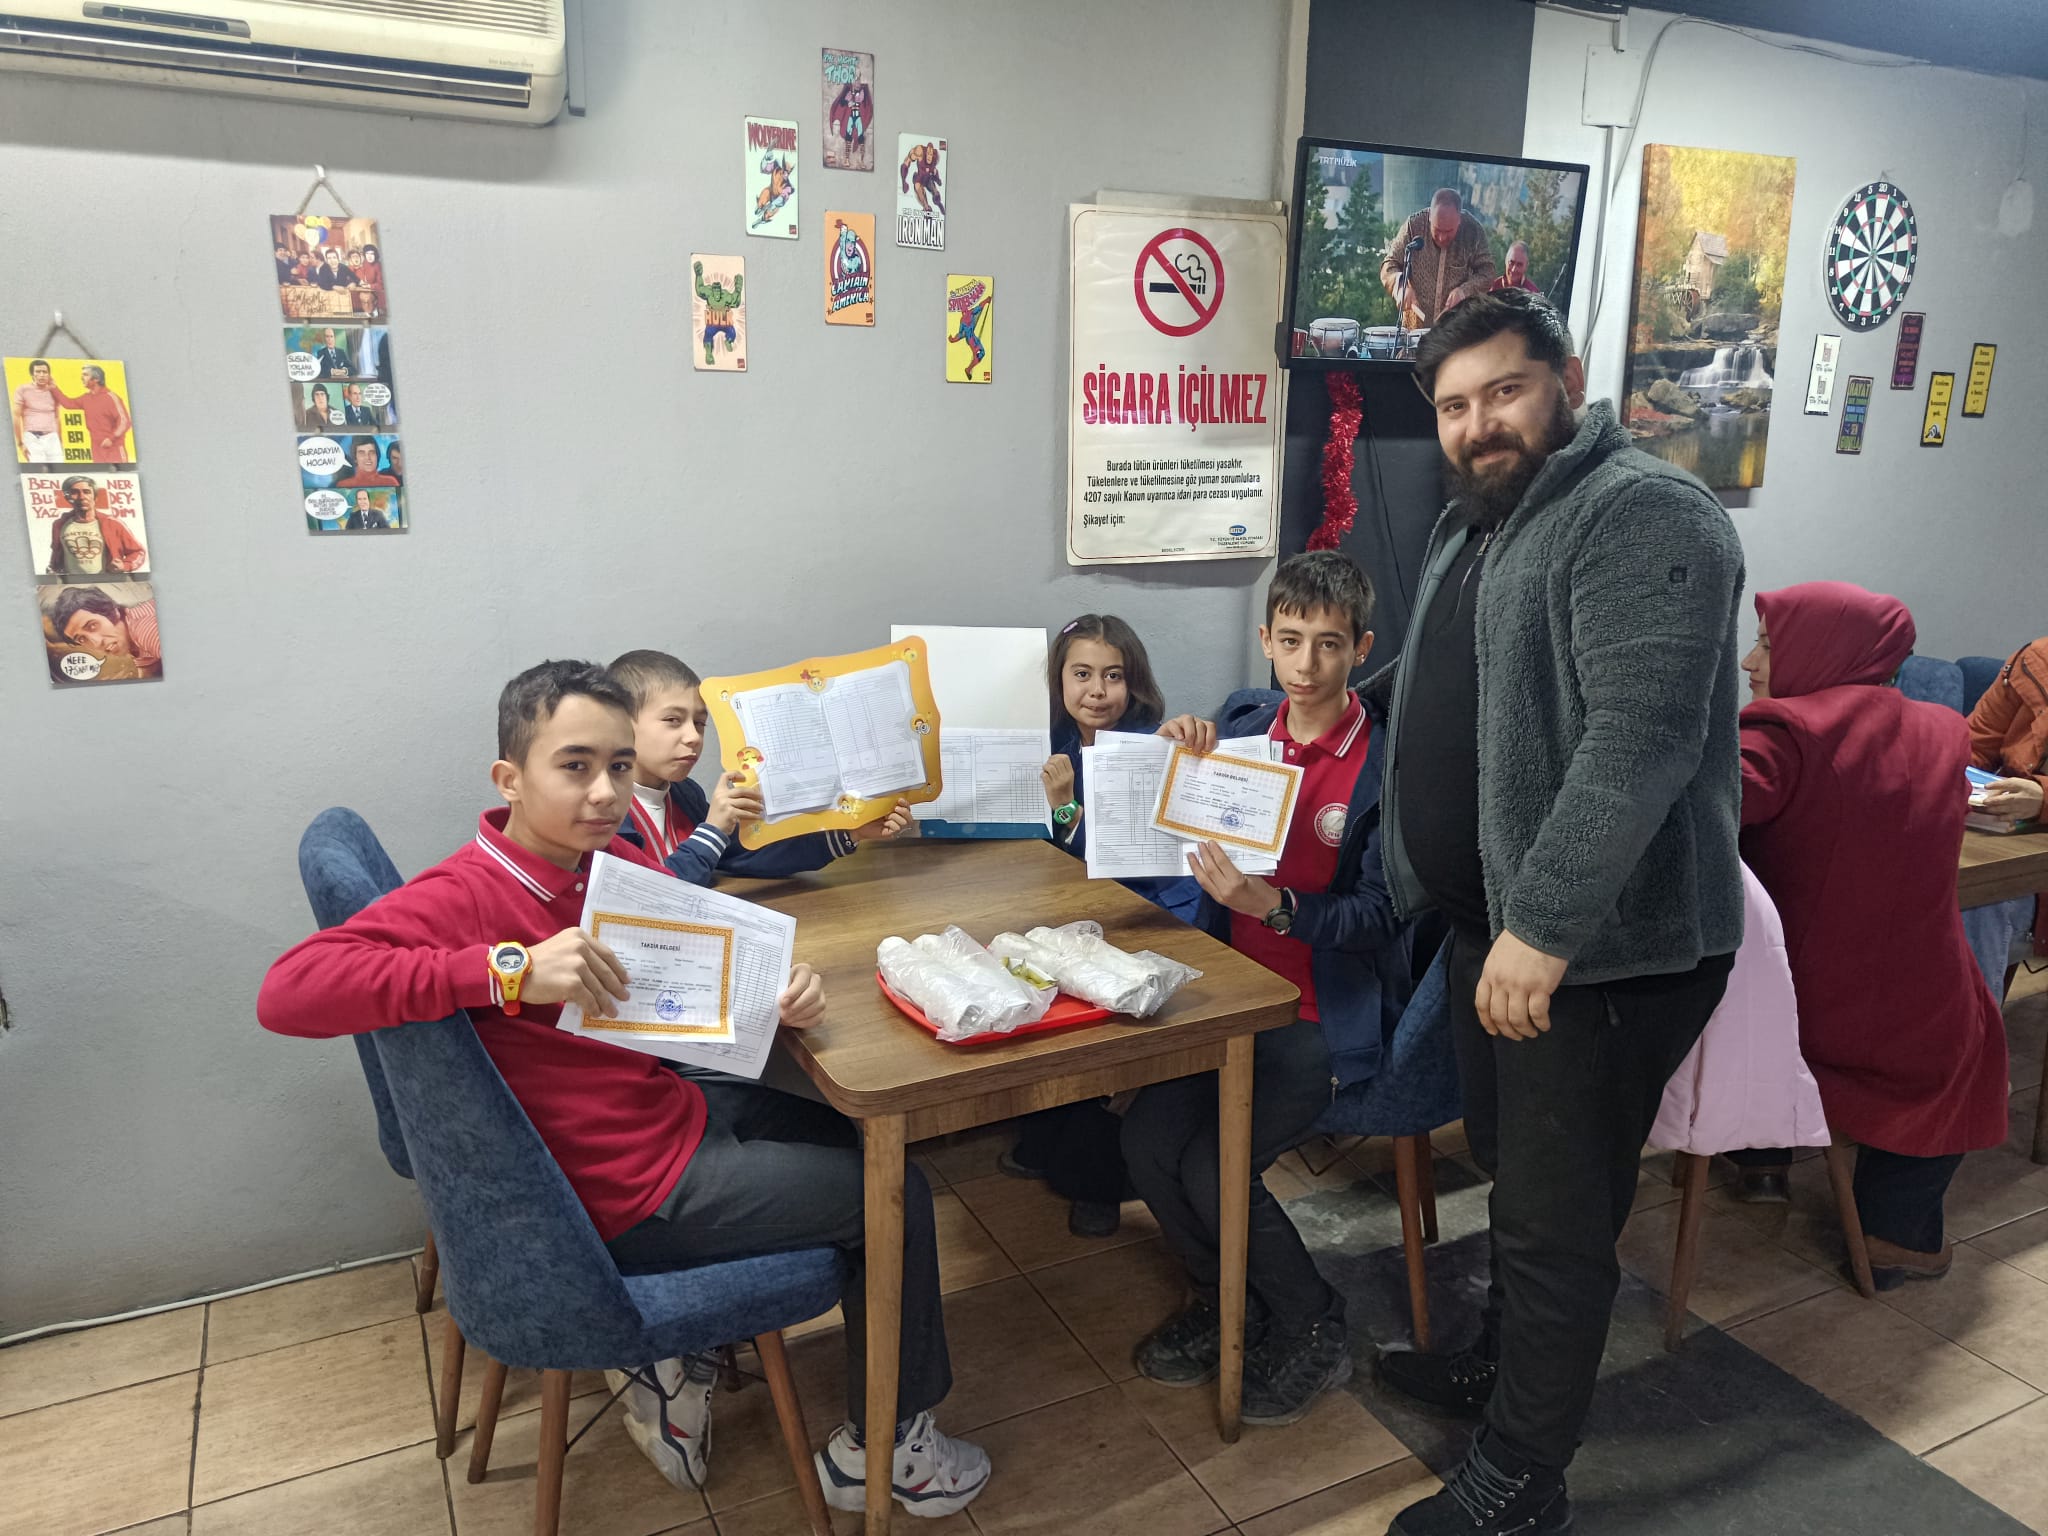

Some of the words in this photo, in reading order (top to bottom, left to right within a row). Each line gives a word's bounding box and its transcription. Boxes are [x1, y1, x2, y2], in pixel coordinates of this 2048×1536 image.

[824, 64, 857, 85] THOR
[746, 121, 797, 152] WOLVERINE
[1867, 185, 1873, 195] 5
[1878, 183, 1888, 193] 20
[1908, 215, 1914, 225] 4
[897, 215, 922, 245] IRON
[922, 217, 945, 248] MAN
[1910, 254, 1916, 264] 6
[830, 276, 869, 296] CAPTAIN
[831, 291, 869, 313] AMERICA
[1838, 303, 1845, 312] 7
[704, 308, 734, 326] HULK
[1848, 313, 1856, 322] 19
[1860, 317, 1867, 326] 3
[1871, 315, 1881, 324] 17
[1083, 364, 1172, 425] SİGARA
[1178, 364, 1268, 432] İÇİLMEZ
[64, 413, 82, 426] HA
[67, 431, 84, 443] BA
[64, 449, 92, 461] BAM
[298, 447, 341, 457] BURADAYIM
[306, 458, 336, 467] HOCAM!
[1106, 460, 1132, 471] Burada
[1133, 459, 1151, 471] tütün
[1152, 459, 1179, 471] ürünleri
[1180, 458, 1215, 470] tüketilmesi
[1216, 458, 1242, 471] yasaktır.
[27, 477, 60, 490] BEN
[106, 479, 134, 490] NER-
[1087, 475, 1129, 487] Tüketenlere
[1130, 477, 1138, 486] ve
[1140, 474, 1185, 486] tüketilmesine
[1185, 473, 1197, 487] göz
[1198, 475, 1220, 486] yuman
[1220, 472, 1261, 484] sorumlulara
[30, 492, 52, 505] BU
[108, 491, 135, 505] DEY-
[1083, 491, 1102, 503] 4207
[1103, 490, 1122, 504] sayılı
[1123, 490, 1146, 502] Kanun
[1146, 490, 1176, 503] uyarınca
[1176, 488, 1192, 500] idari
[1192, 490, 1208, 501] para
[1208, 488, 1230, 499] cezası
[1231, 487, 1264, 500] uygulanır.
[31, 506, 59, 519] YAZ
[1083, 513, 1109, 528] Şikayet
[1110, 513, 1126, 527] için:
[640, 941, 659, 950] TAKDİR
[659, 943, 681, 952] BELGESİ
